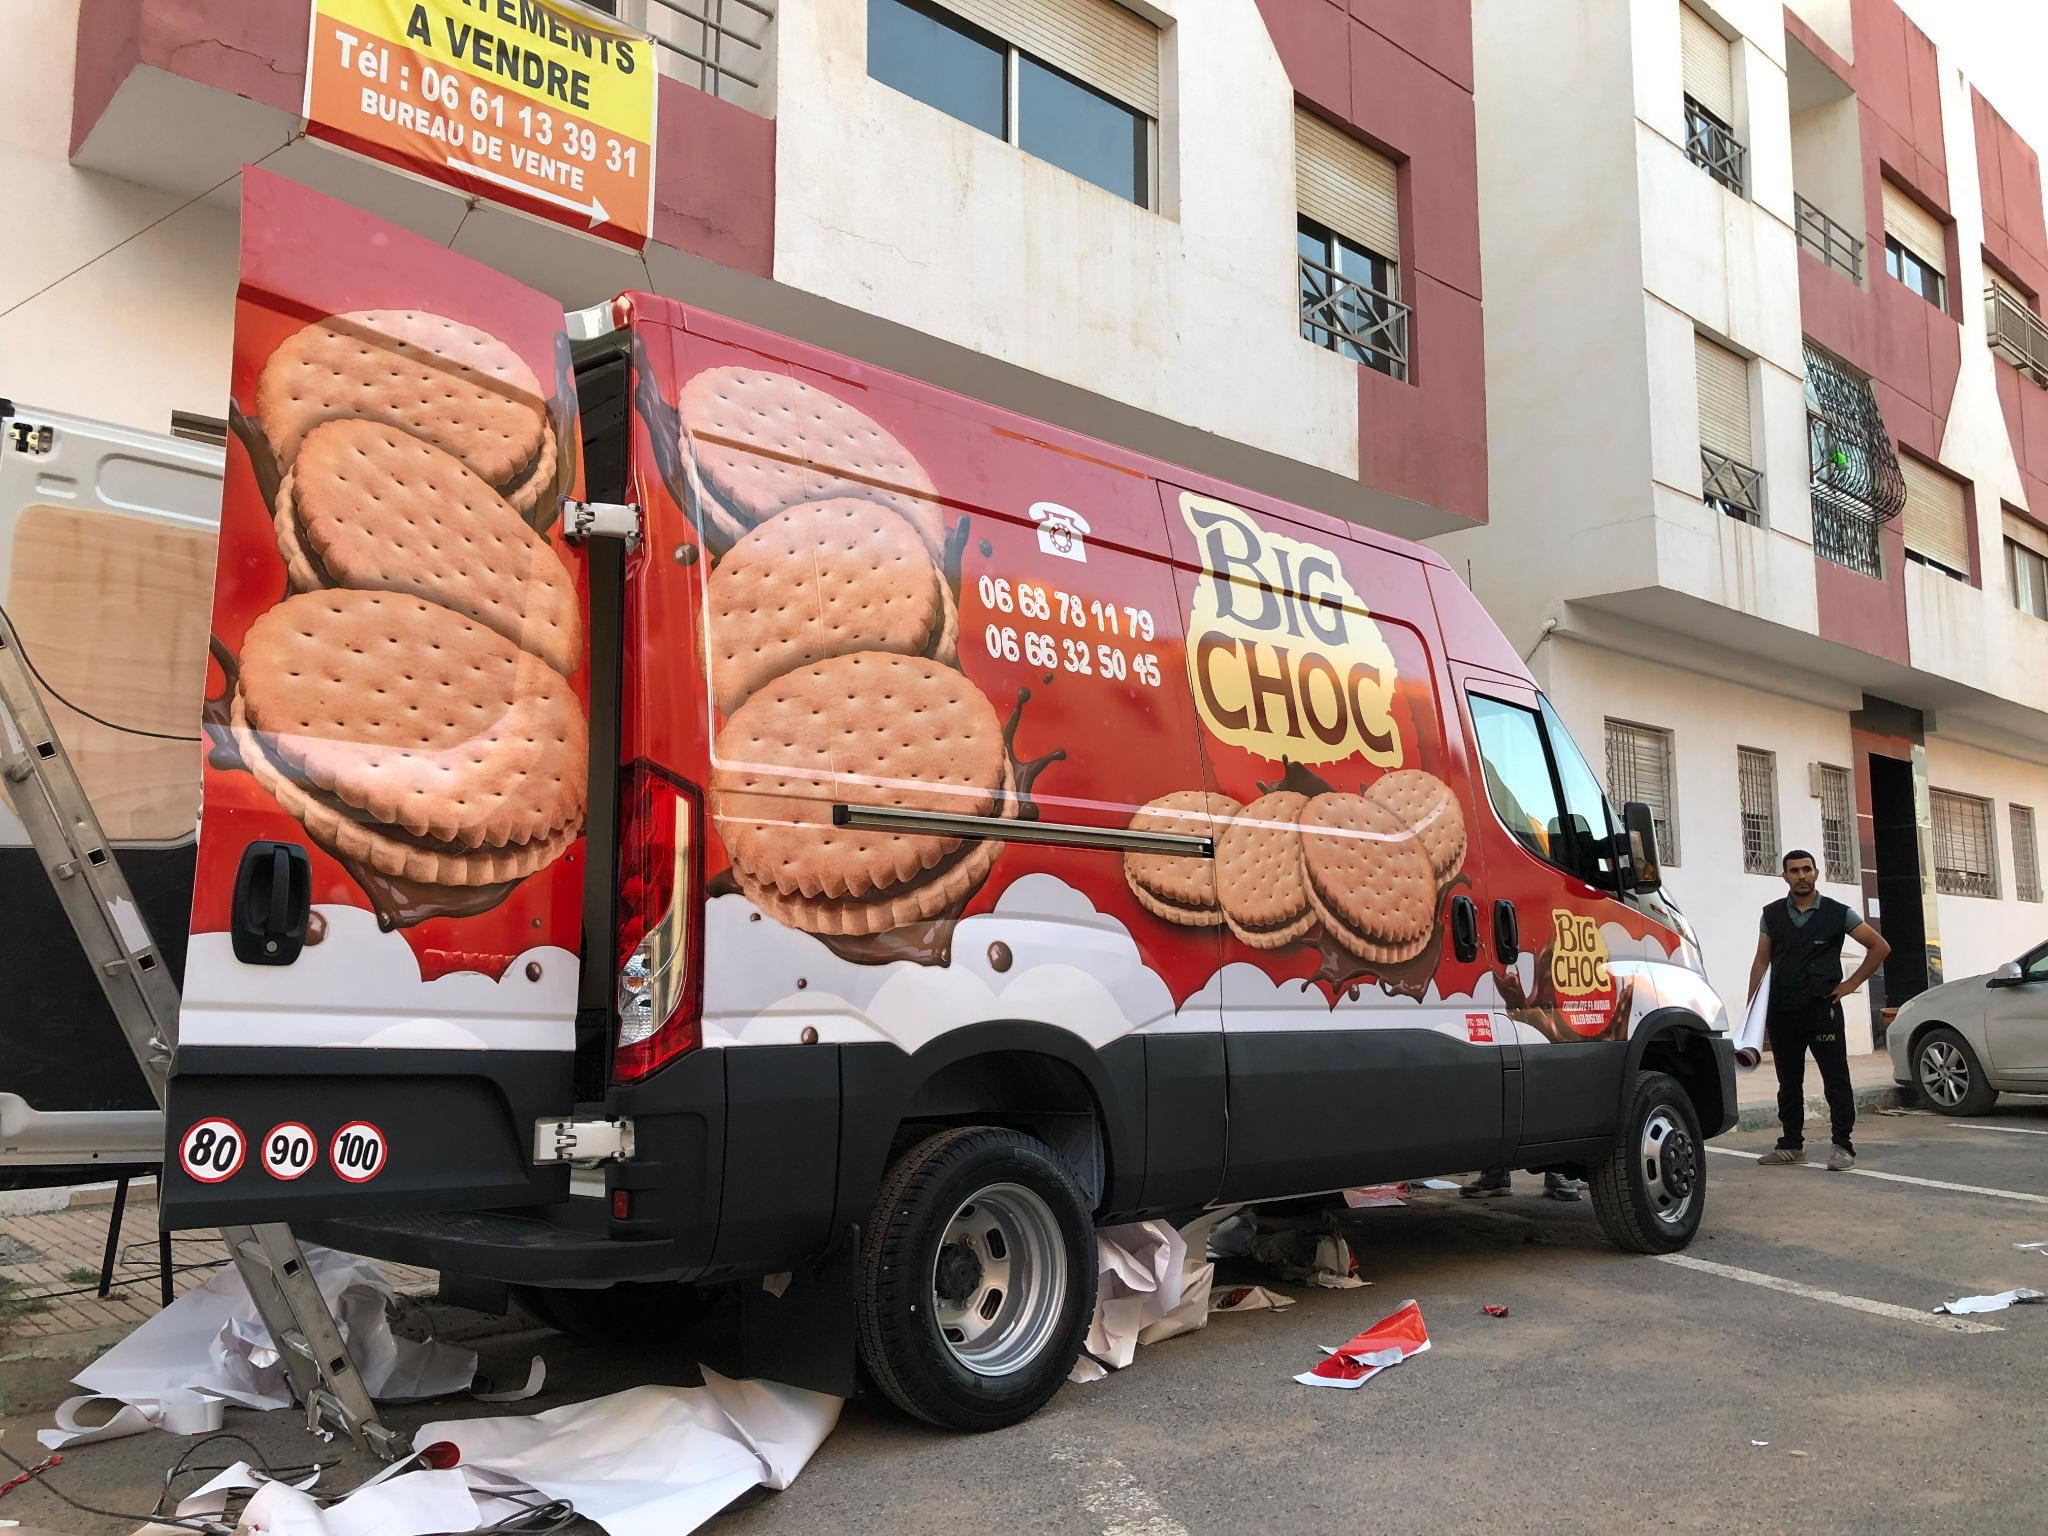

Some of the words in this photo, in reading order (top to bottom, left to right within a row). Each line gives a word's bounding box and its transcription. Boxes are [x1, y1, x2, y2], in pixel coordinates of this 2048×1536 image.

[406, 4, 432, 48] A
[445, 17, 590, 110] VENDRE
[463, 0, 635, 75] EMENTS
[335, 30, 388, 83] Tél
[421, 66, 459, 110] 06
[470, 87, 504, 128] 61
[518, 105, 553, 145] 13
[563, 122, 597, 162] 39
[606, 139, 636, 178] 31
[360, 87, 464, 147] BUREAU
[471, 130, 502, 162] DE
[510, 143, 584, 192] VENTE
[979, 575, 1013, 613] 06
[1018, 583, 1050, 621] 68
[1054, 591, 1086, 628] 78
[1090, 600, 1118, 635] 11
[1123, 606, 1154, 642] 79
[1190, 507, 1349, 647] BIG
[985, 624, 1020, 662] 06
[1025, 631, 1058, 669] 66
[1063, 639, 1092, 675] 32
[1098, 645, 1127, 681] 50
[1132, 653, 1161, 687] 45
[1196, 630, 1395, 753] CHOC
[1555, 913, 1596, 952] BIG
[1554, 955, 1609, 988] CHOC
[188, 1128, 237, 1172] 80
[270, 1135, 309, 1168] 90
[338, 1132, 379, 1171] 100
